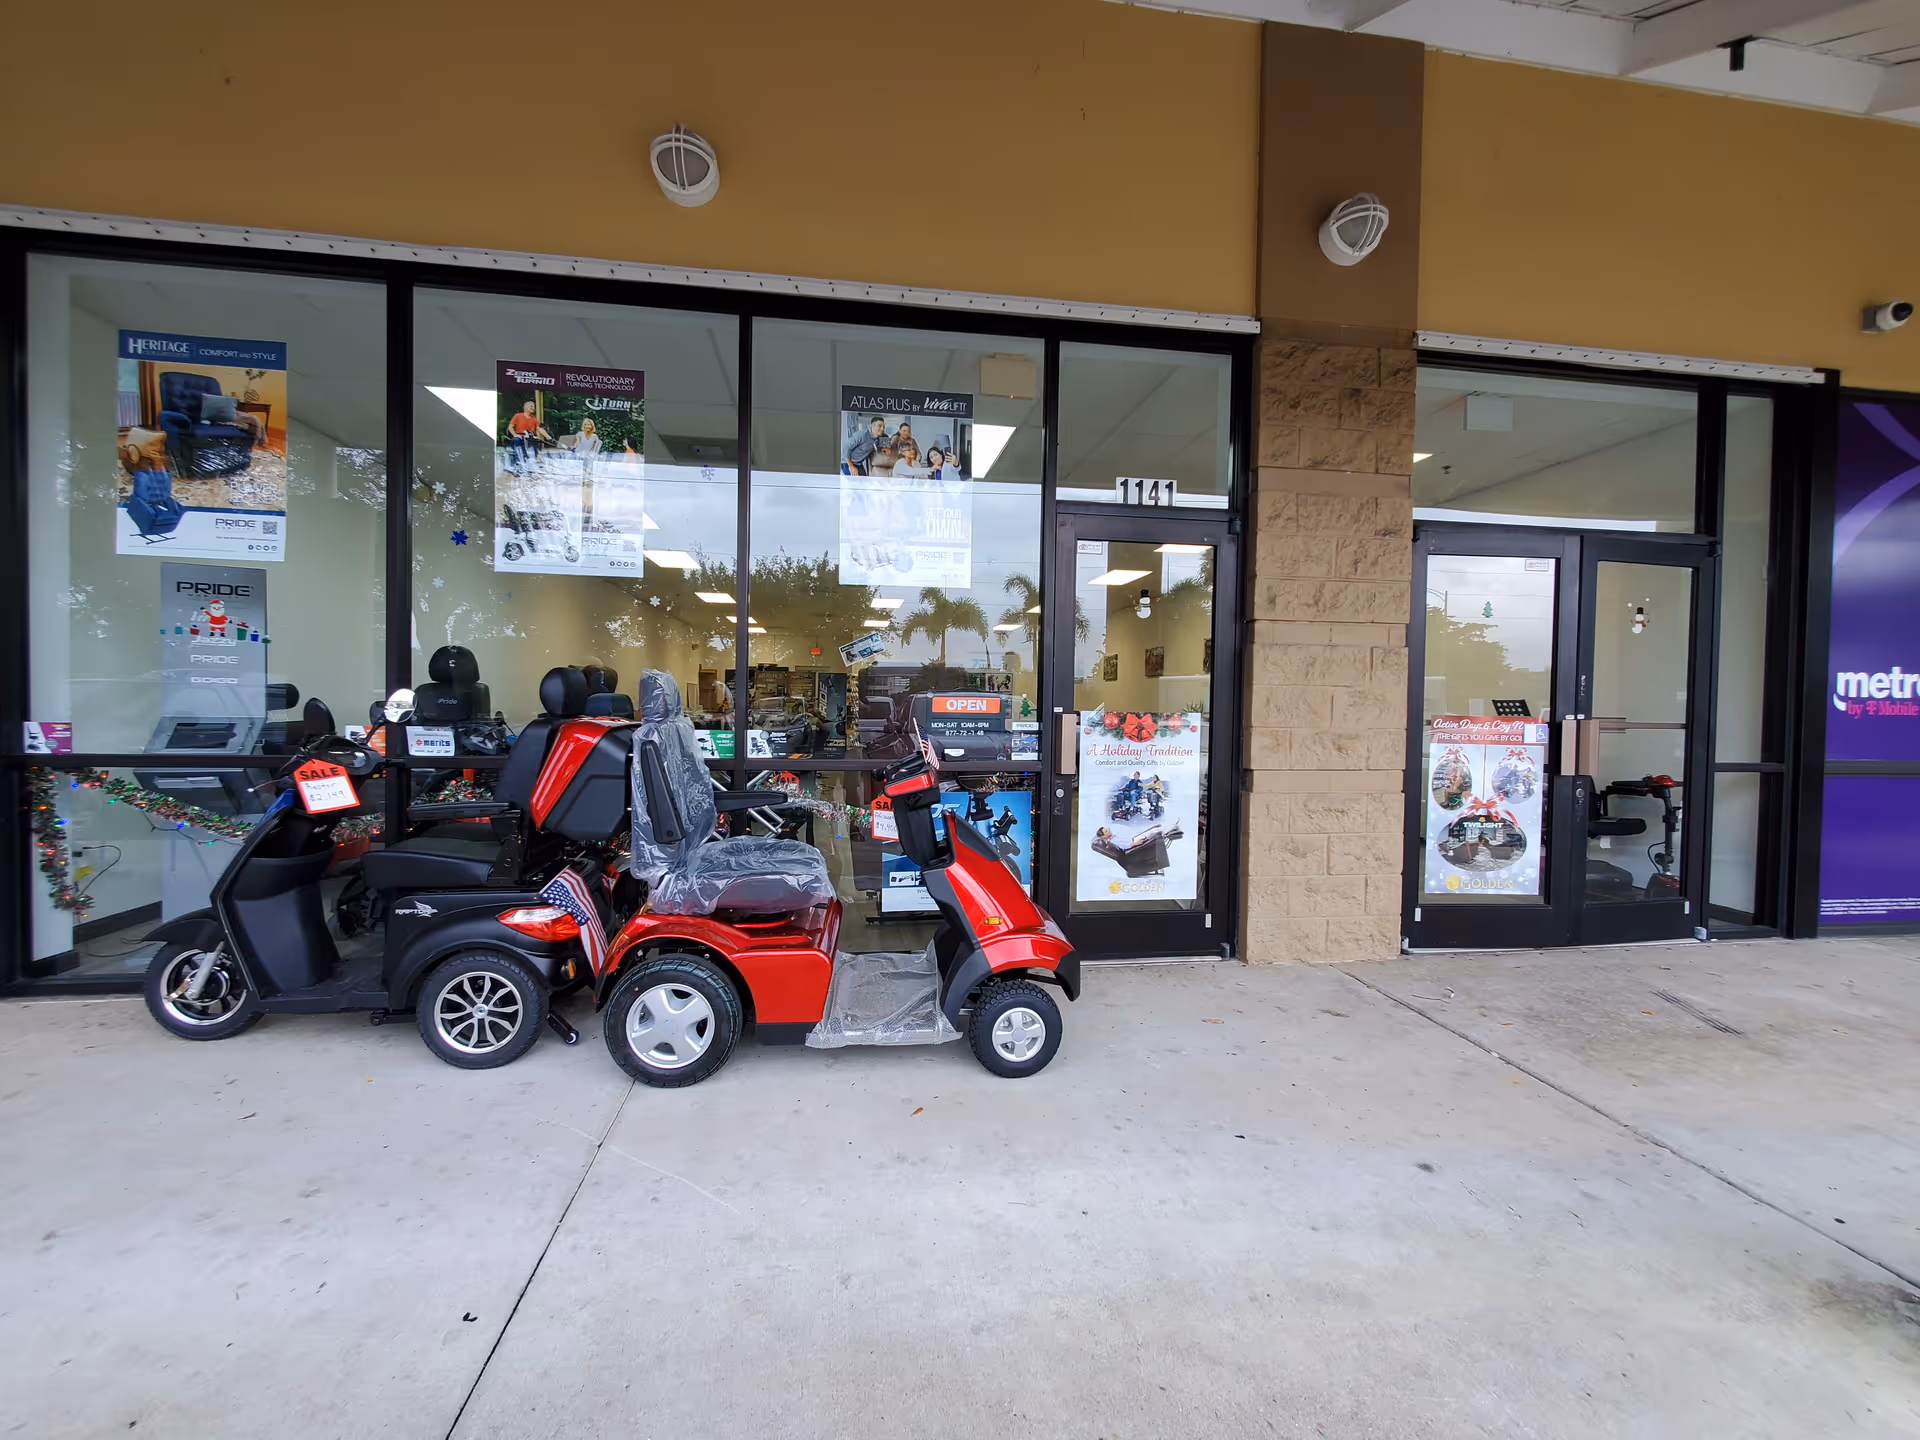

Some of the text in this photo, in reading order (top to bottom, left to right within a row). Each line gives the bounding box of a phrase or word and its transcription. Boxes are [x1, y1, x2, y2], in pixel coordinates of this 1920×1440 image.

[128, 338, 190, 354] HERITAGE
[200, 348, 238, 358] COMFORT
[252, 352, 277, 361] STYLE
[505, 368, 538, 377] ZERO
[565, 373, 635, 385] REVOLUTIONARY
[566, 381, 635, 391] TURNING TECHNOLOGY
[850, 396, 884, 410] ATLAS
[886, 398, 910, 411] PLUS
[1120, 478, 1174, 506] 1141
[216, 518, 256, 527] PRIDE
[581, 537, 617, 545] PRIDE
[176, 581, 250, 597] PRIDE
[190, 655, 240, 664] PRIDE
[1836, 666, 1920, 698] metr
[946, 699, 987, 711] OPEN
[1847, 700, 1864, 719] by
[1433, 719, 1459, 729] Active
[1460, 719, 1482, 732] Days
[1483, 721, 1490, 730] &
[1492, 720, 1510, 733] Cozy
[1451, 733, 1469, 741] GIFTS
[1086, 744, 1193, 760] A Holiday Tradition
[300, 766, 340, 780] SALE
[875, 800, 892, 810] SA
[1463, 821, 1504, 829] TWILIGHT
[1121, 882, 1165, 893] GOLDEN
[1460, 878, 1514, 890] GOLDEN
